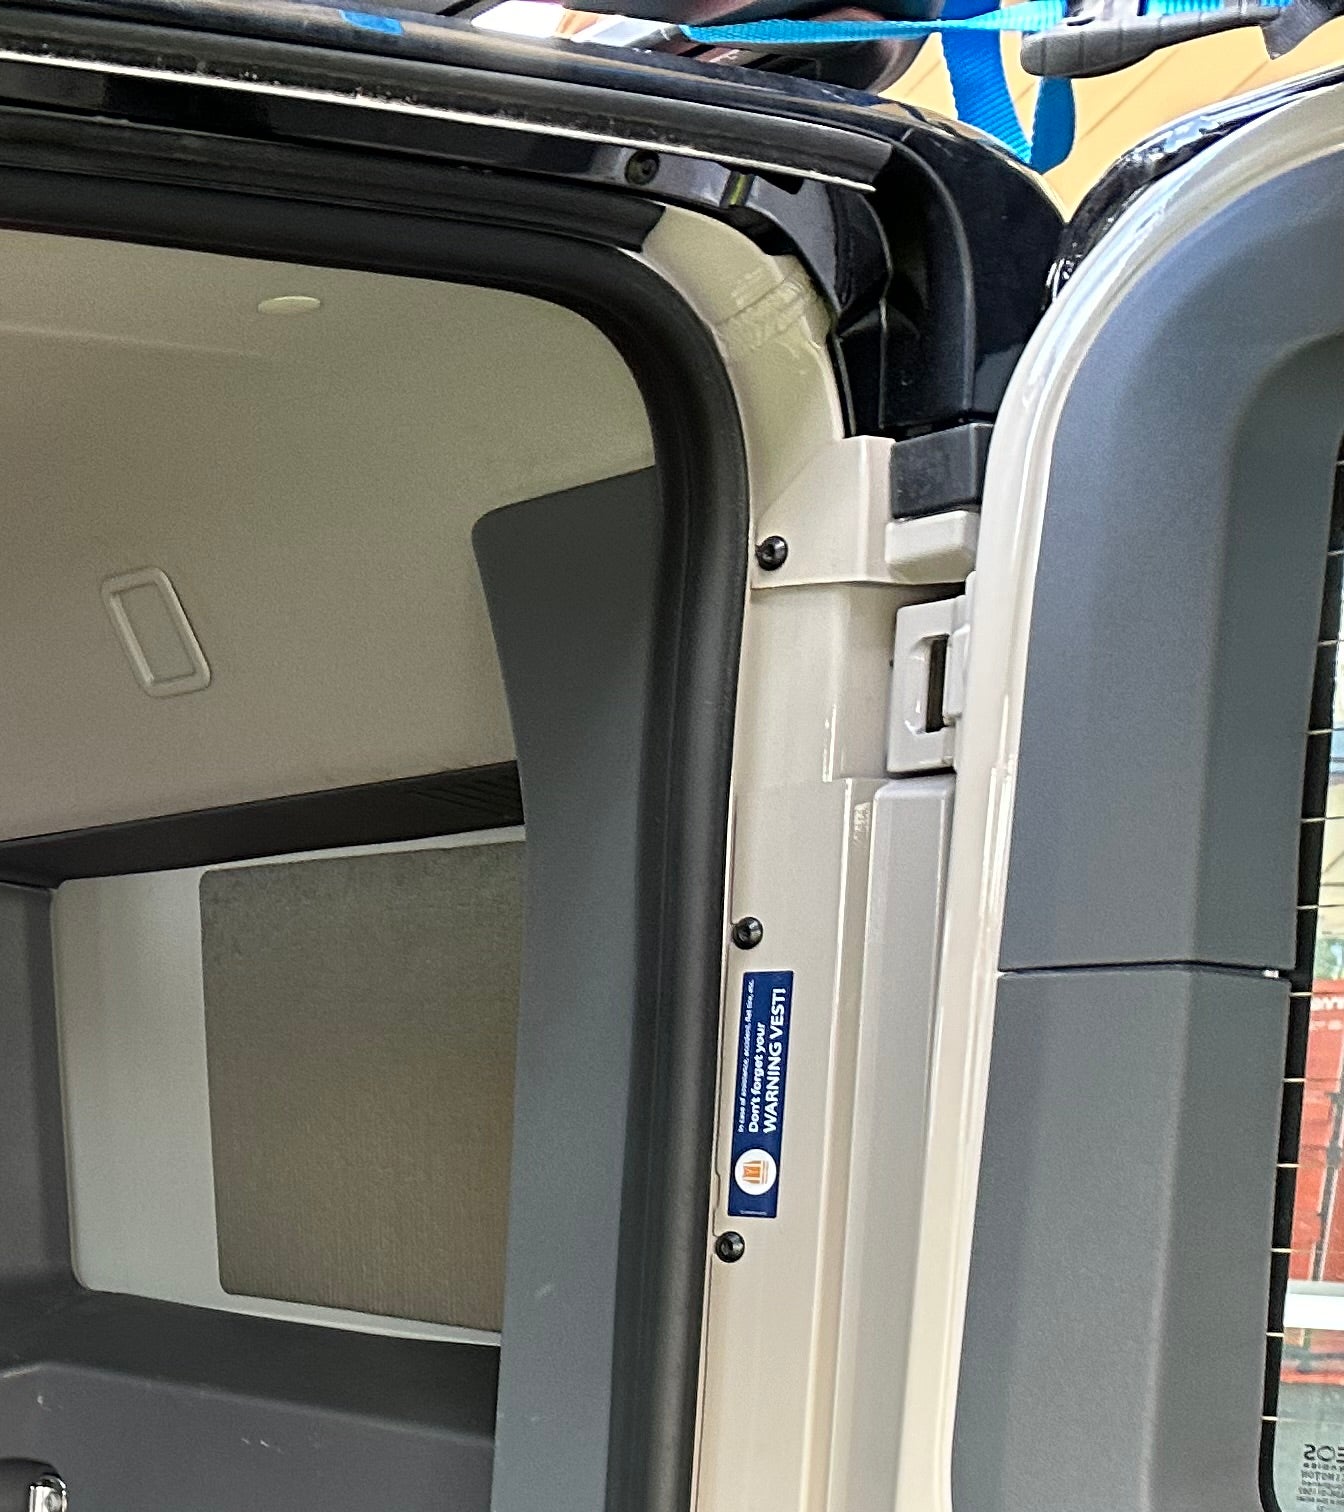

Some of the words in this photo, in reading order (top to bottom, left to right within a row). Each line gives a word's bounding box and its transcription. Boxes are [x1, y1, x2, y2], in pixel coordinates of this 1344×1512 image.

[755, 1021, 766, 1054] your
[750, 1054, 765, 1095] forget
[762, 1041, 782, 1134] WARNING
[748, 1096, 761, 1133] Don't
